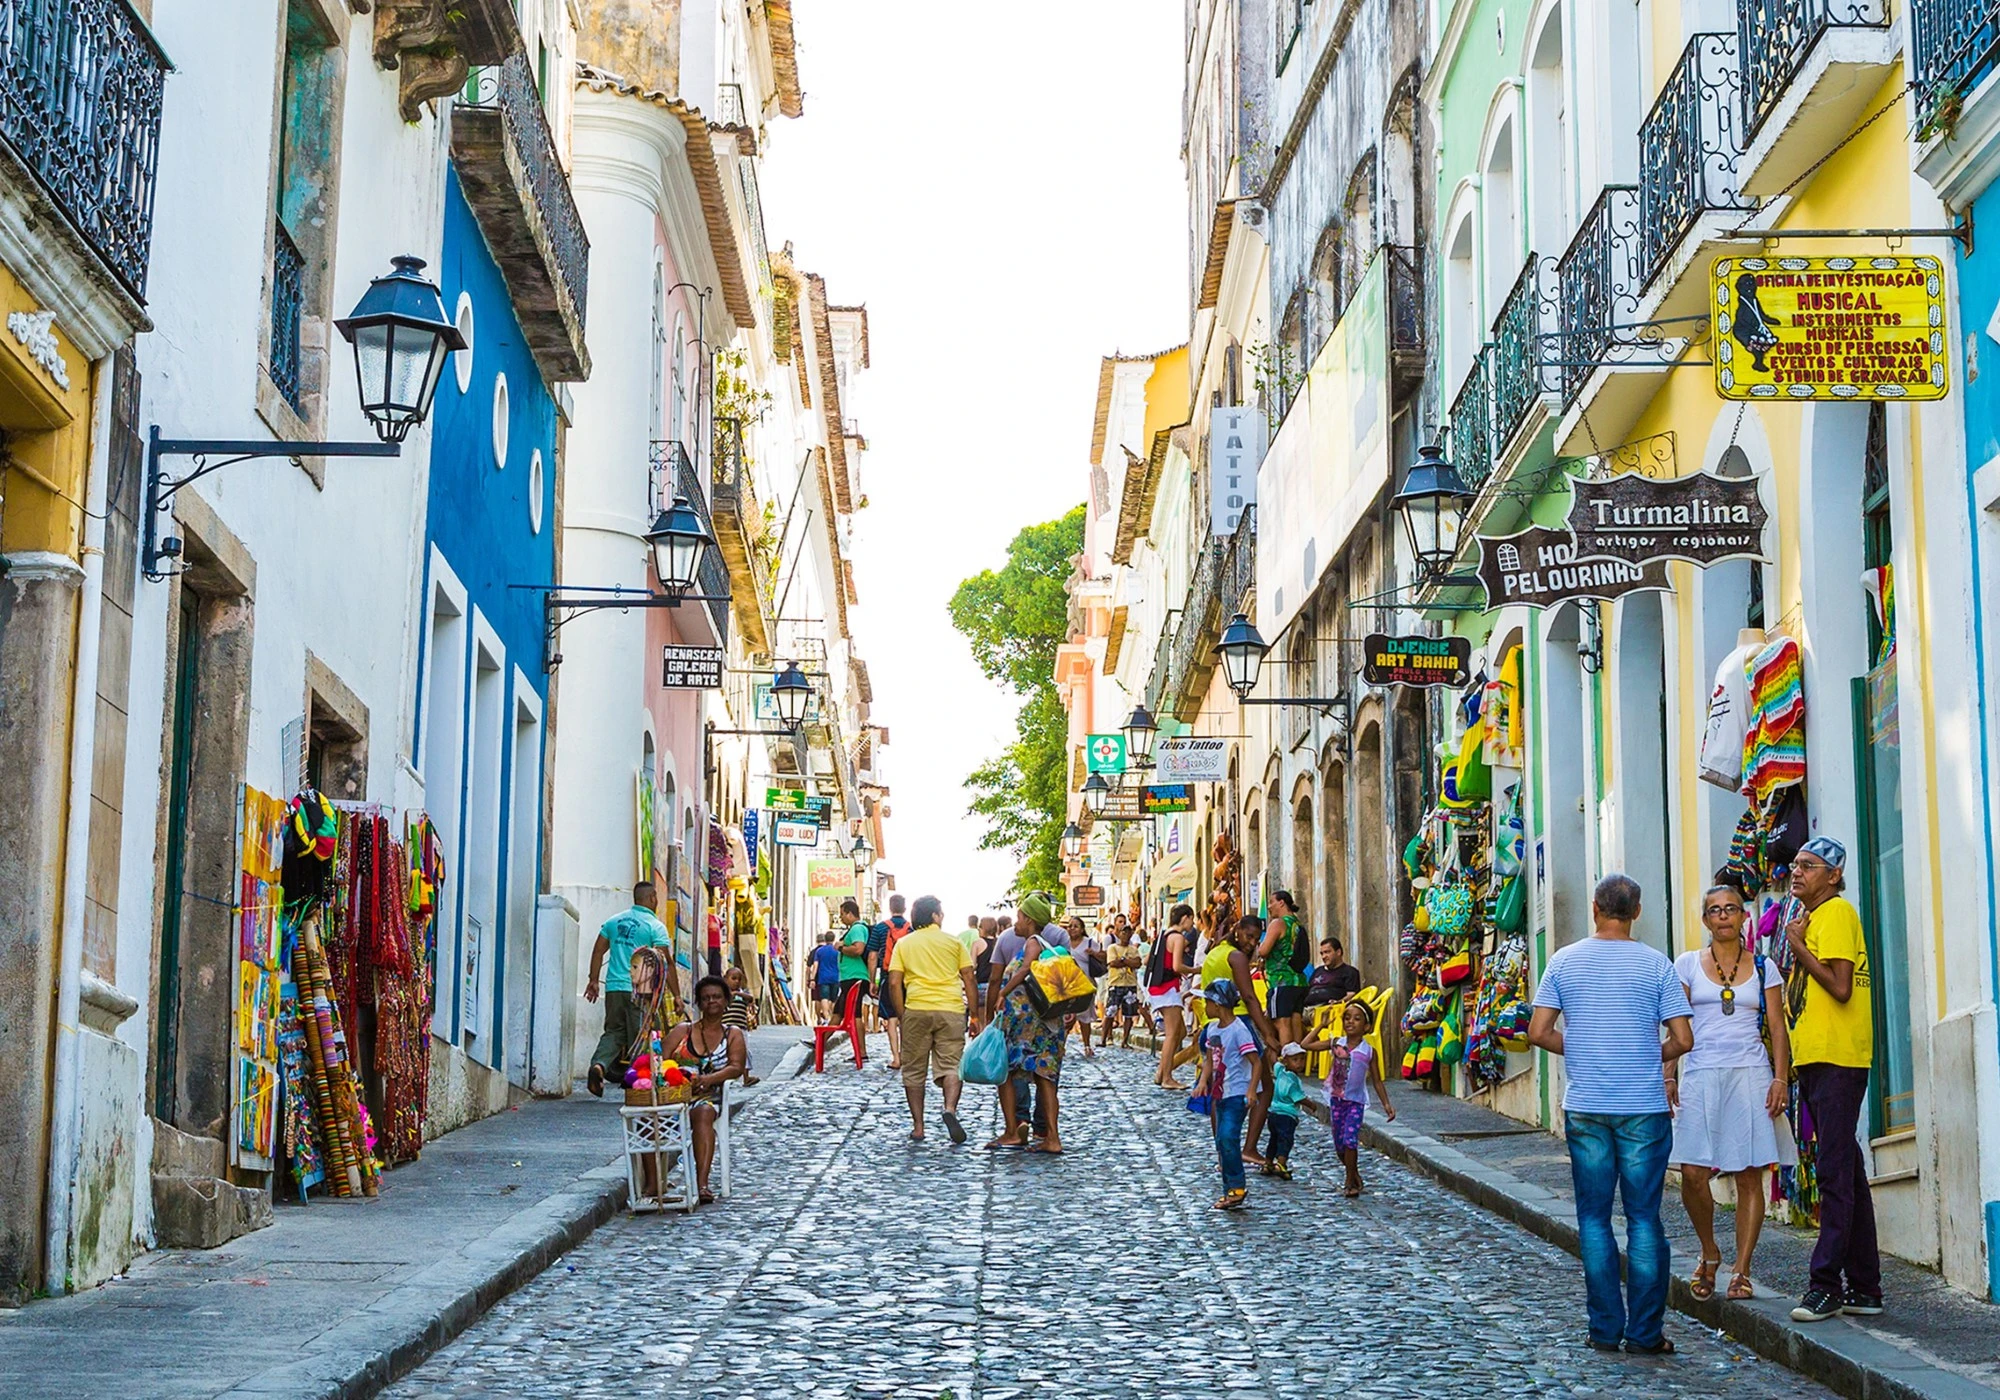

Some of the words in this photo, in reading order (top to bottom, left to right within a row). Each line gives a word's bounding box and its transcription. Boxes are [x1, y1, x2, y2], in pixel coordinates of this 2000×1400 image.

[1756, 274, 1804, 287] OFICINA
[1805, 274, 1823, 287] DE
[1797, 292, 1882, 311] MUSICAL
[1792, 313, 1902, 327] INSTRUMENTOS
[1806, 327, 1874, 341] MUSICAIS
[1776, 342, 1821, 355] CURSO
[1825, 342, 1842, 355] DE
[1846, 337, 1930, 355] PERCUSSÃO
[1770, 356, 1836, 369] EVENTOS
[1843, 356, 1923, 369] CULTURAIS
[1828, 370, 1844, 383] DE
[1226, 415, 1243, 529] TATTOO
[1589, 498, 1750, 525] Turmalina
[1595, 535, 1656, 549] artigos
[1672, 535, 1750, 549] regionais
[1538, 543, 1573, 567] HO
[1503, 562, 1644, 596] PELOURINHO
[668, 661, 718, 673] GALERIA
[1376, 653, 1407, 667] ART
[1412, 655, 1459, 669] BAHIA
[667, 674, 682, 685] DE
[687, 674, 718, 686] ARTE
[1159, 740, 1187, 750] Zeus
[1188, 740, 1224, 750] Tattoo
[779, 827, 794, 838] GOOD
[799, 828, 815, 839] LUCK
